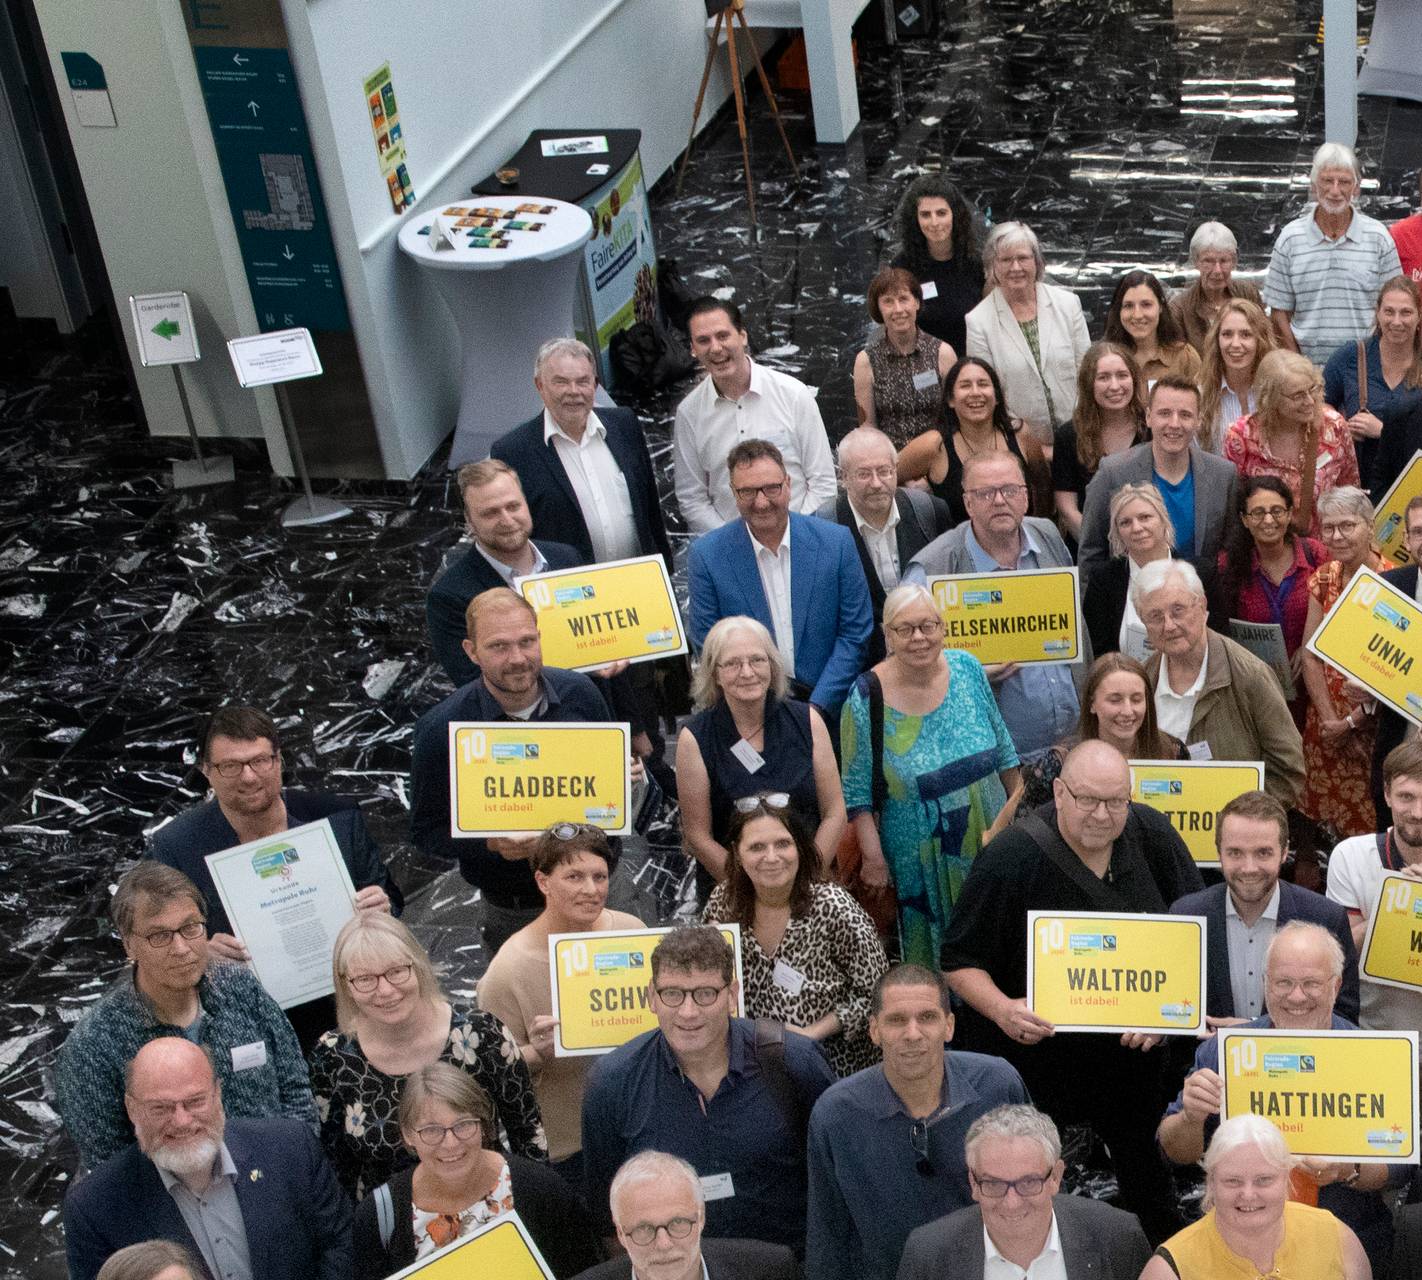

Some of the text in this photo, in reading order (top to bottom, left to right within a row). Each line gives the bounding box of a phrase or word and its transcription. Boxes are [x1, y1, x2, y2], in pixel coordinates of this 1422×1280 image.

[141, 302, 180, 312] Garderobe
[528, 582, 550, 612] 10
[937, 582, 958, 611] 10
[568, 607, 640, 637] WITTEN
[576, 640, 588, 649] ist
[1368, 633, 1414, 676] UNNA
[460, 730, 486, 764] 10
[484, 776, 596, 798] GLADBECK
[484, 802, 497, 812] ist
[1164, 811, 1219, 831] TTRO
[1386, 882, 1412, 913] 10
[1039, 920, 1064, 954] 10
[561, 942, 588, 977] 10
[1408, 958, 1420, 967] ist
[1067, 968, 1167, 992] WALTROP
[590, 986, 650, 1012] SCHW
[1070, 996, 1082, 1006] ist
[592, 1017, 606, 1027] ist
[1230, 1039, 1257, 1076] 10
[1250, 1091, 1384, 1118] HATTINGEN
